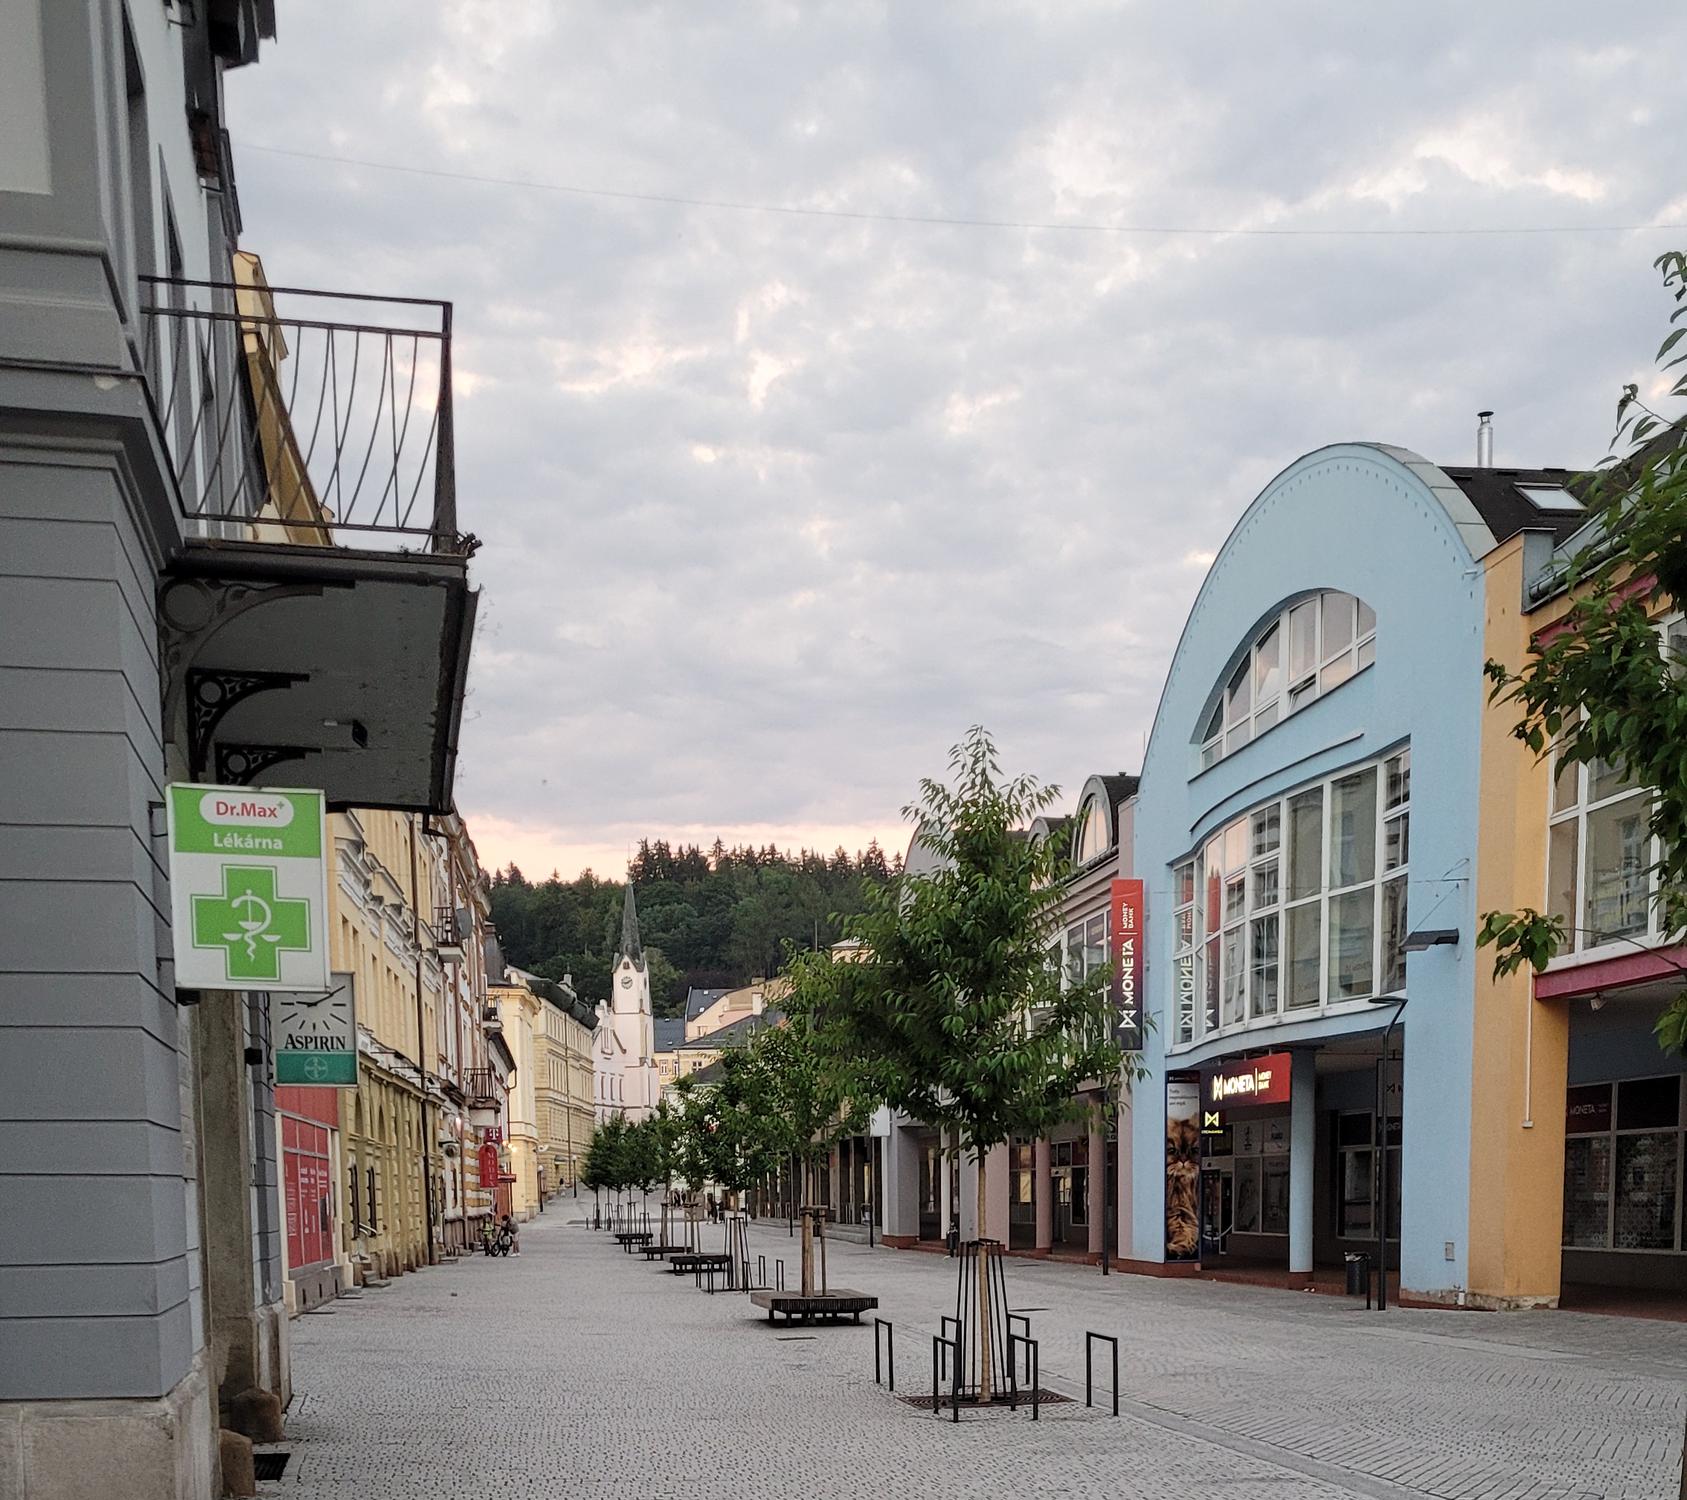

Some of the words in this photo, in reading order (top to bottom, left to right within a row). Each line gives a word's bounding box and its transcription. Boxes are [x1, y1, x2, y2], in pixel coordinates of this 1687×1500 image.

[212, 832, 284, 850] Lékárna
[1122, 938, 1134, 1005] MONETA
[284, 1033, 346, 1052] ASPIRIN
[1223, 1074, 1254, 1095] MONETA
